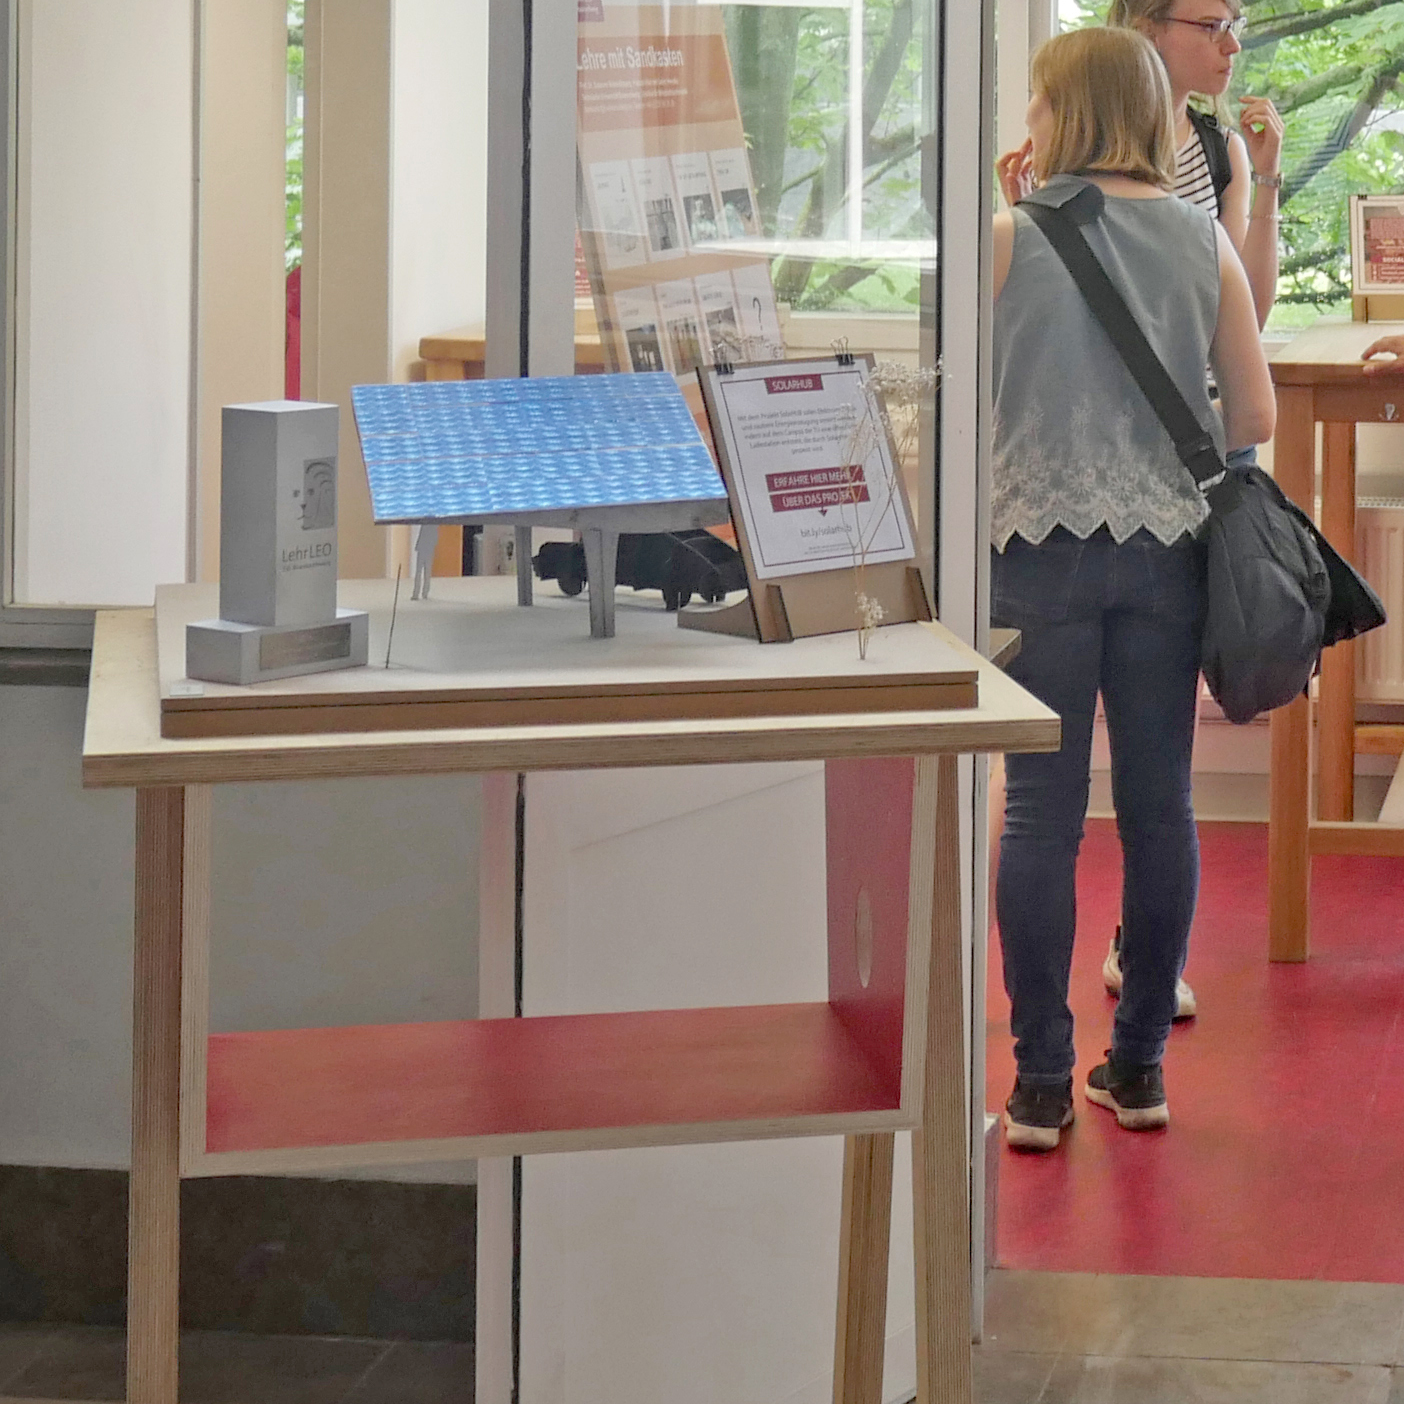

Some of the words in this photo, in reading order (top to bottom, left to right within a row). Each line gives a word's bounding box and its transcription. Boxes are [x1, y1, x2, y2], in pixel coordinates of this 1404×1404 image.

[607, 47, 625, 69] mit
[625, 46, 684, 69] Sandkasten
[771, 378, 814, 392] SOLARHUB
[773, 474, 810, 488] ERFAHRE
[810, 472, 829, 484] HIER
[782, 494, 805, 507] ÜBER
[804, 492, 822, 505] DAS
[282, 542, 332, 563] LehrLEO
